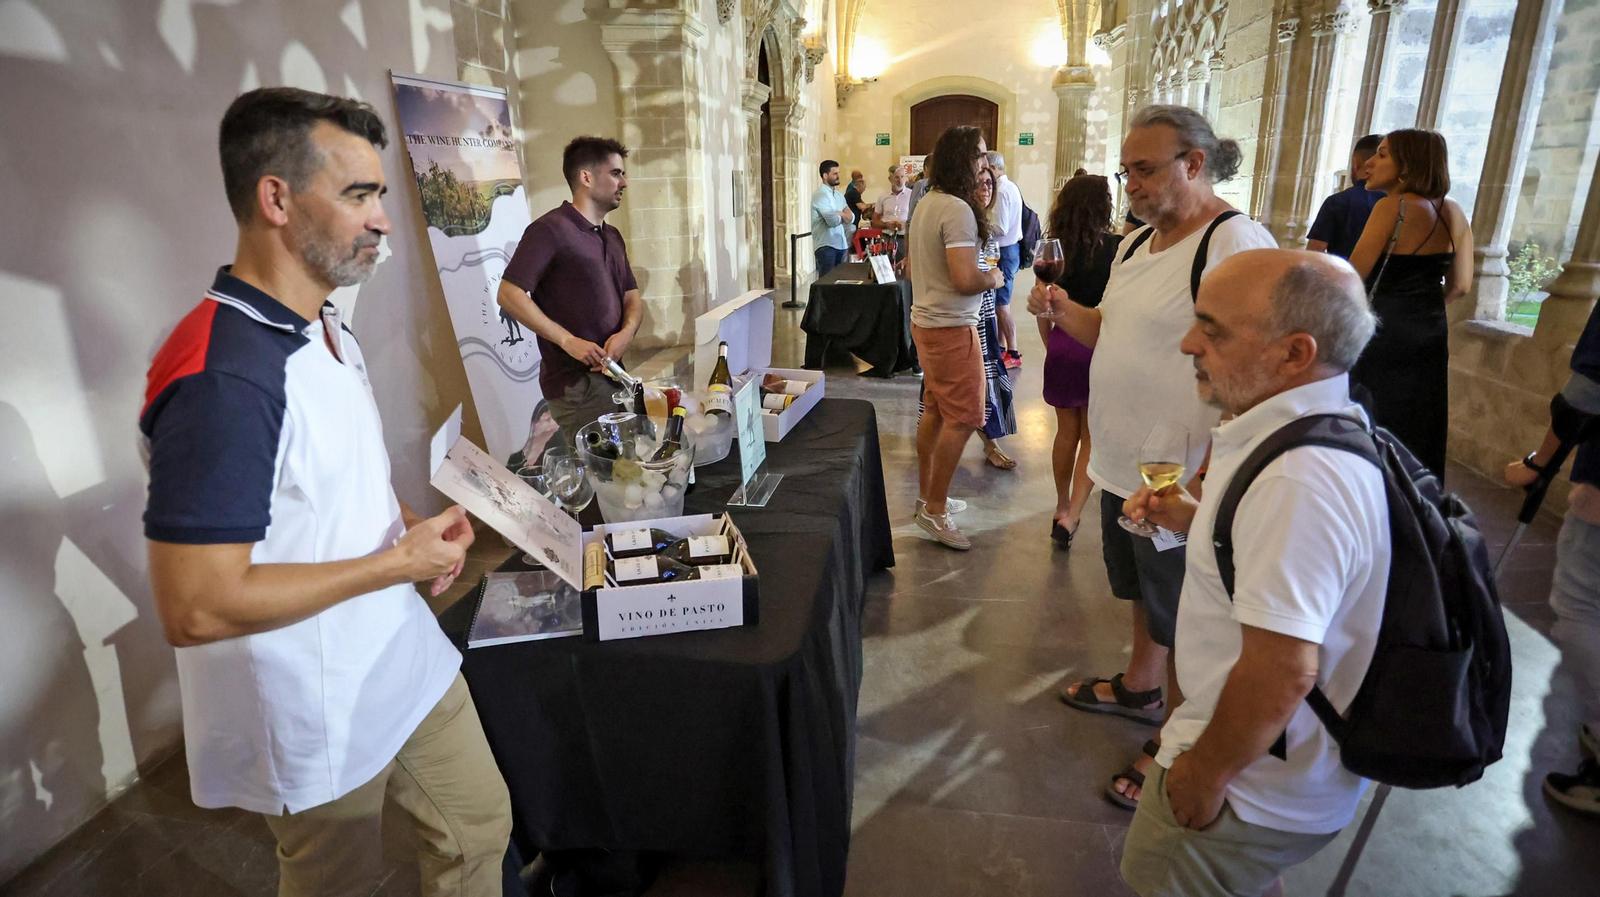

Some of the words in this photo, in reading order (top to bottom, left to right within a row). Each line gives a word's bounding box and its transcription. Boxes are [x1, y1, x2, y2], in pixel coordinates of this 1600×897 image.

[407, 134, 426, 144] THE
[427, 136, 451, 146] WINE
[452, 137, 481, 147] HUNTER
[493, 341, 532, 363] OMPANY
[618, 610, 653, 621] VINO
[659, 608, 676, 618] DE
[682, 603, 725, 616] PASTO
[621, 622, 676, 633] EDICIÓN
